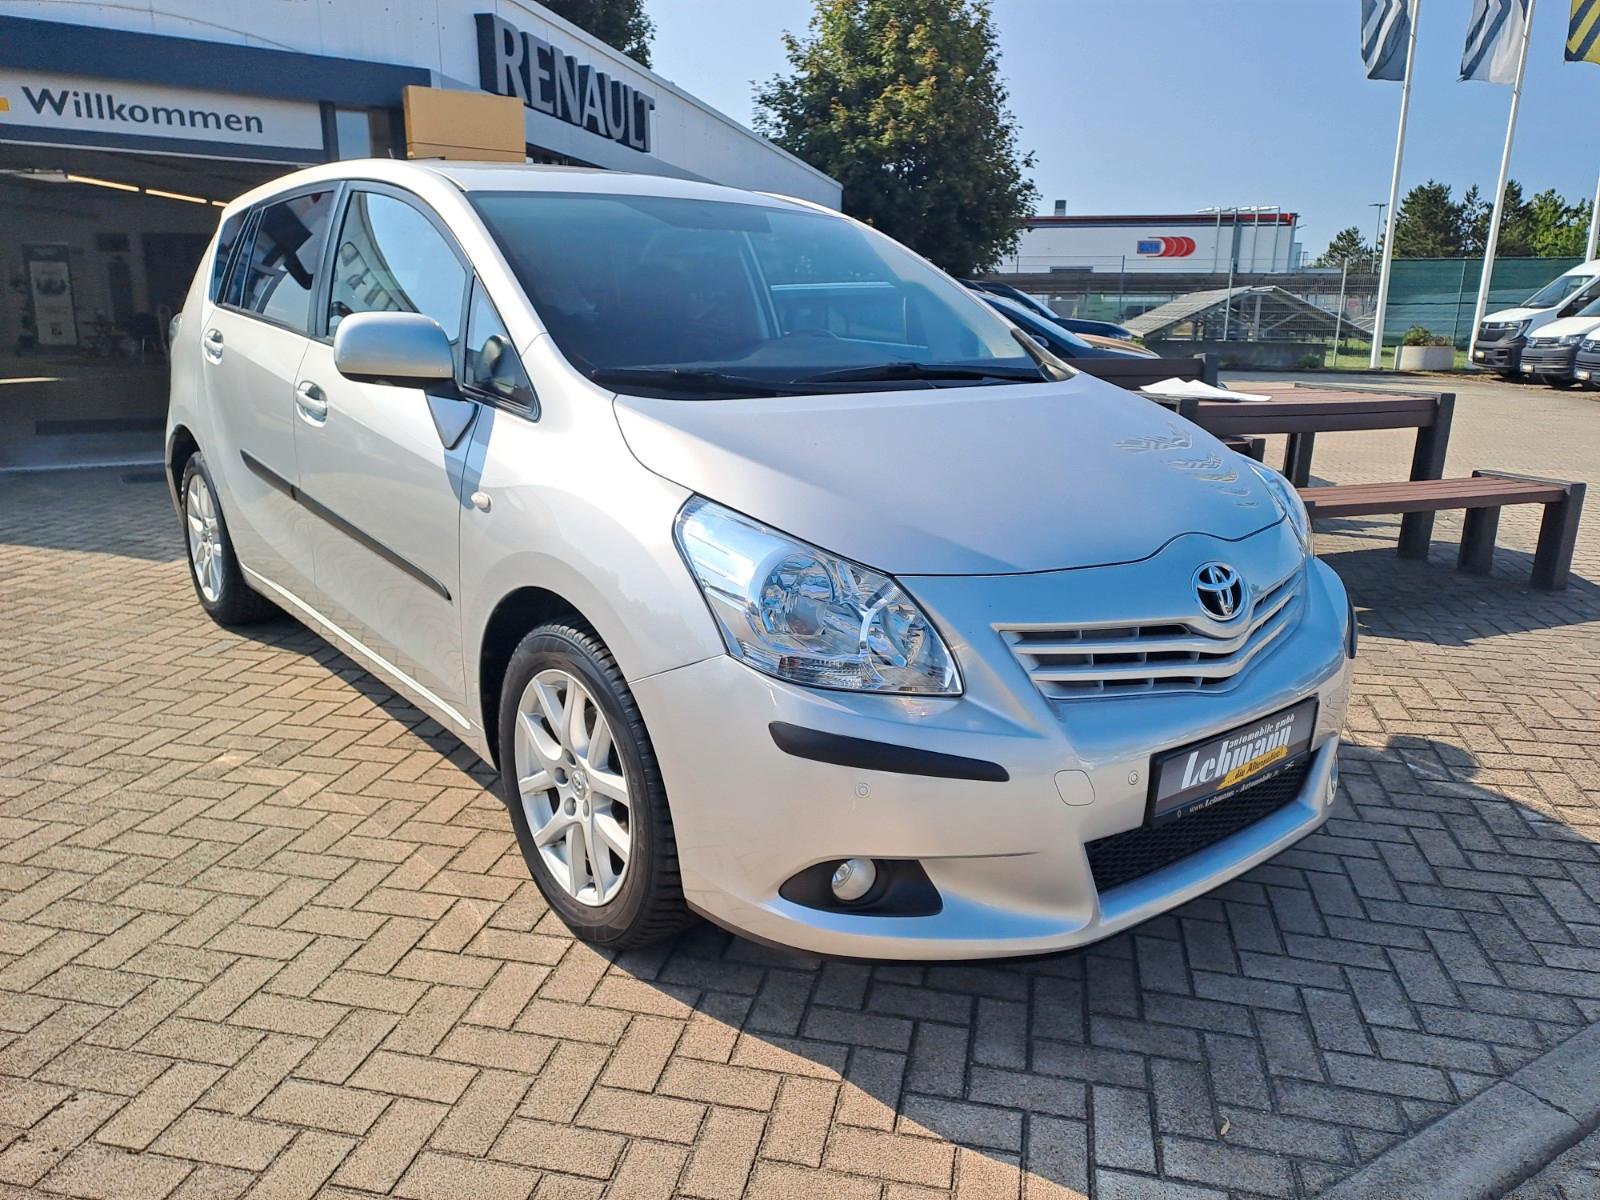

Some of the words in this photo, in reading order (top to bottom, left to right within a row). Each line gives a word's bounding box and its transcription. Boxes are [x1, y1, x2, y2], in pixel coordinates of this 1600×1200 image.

[21, 86, 264, 134] Willkommen
[493, 12, 656, 152] RENAULT
[1181, 726, 1292, 790] Lehmann
